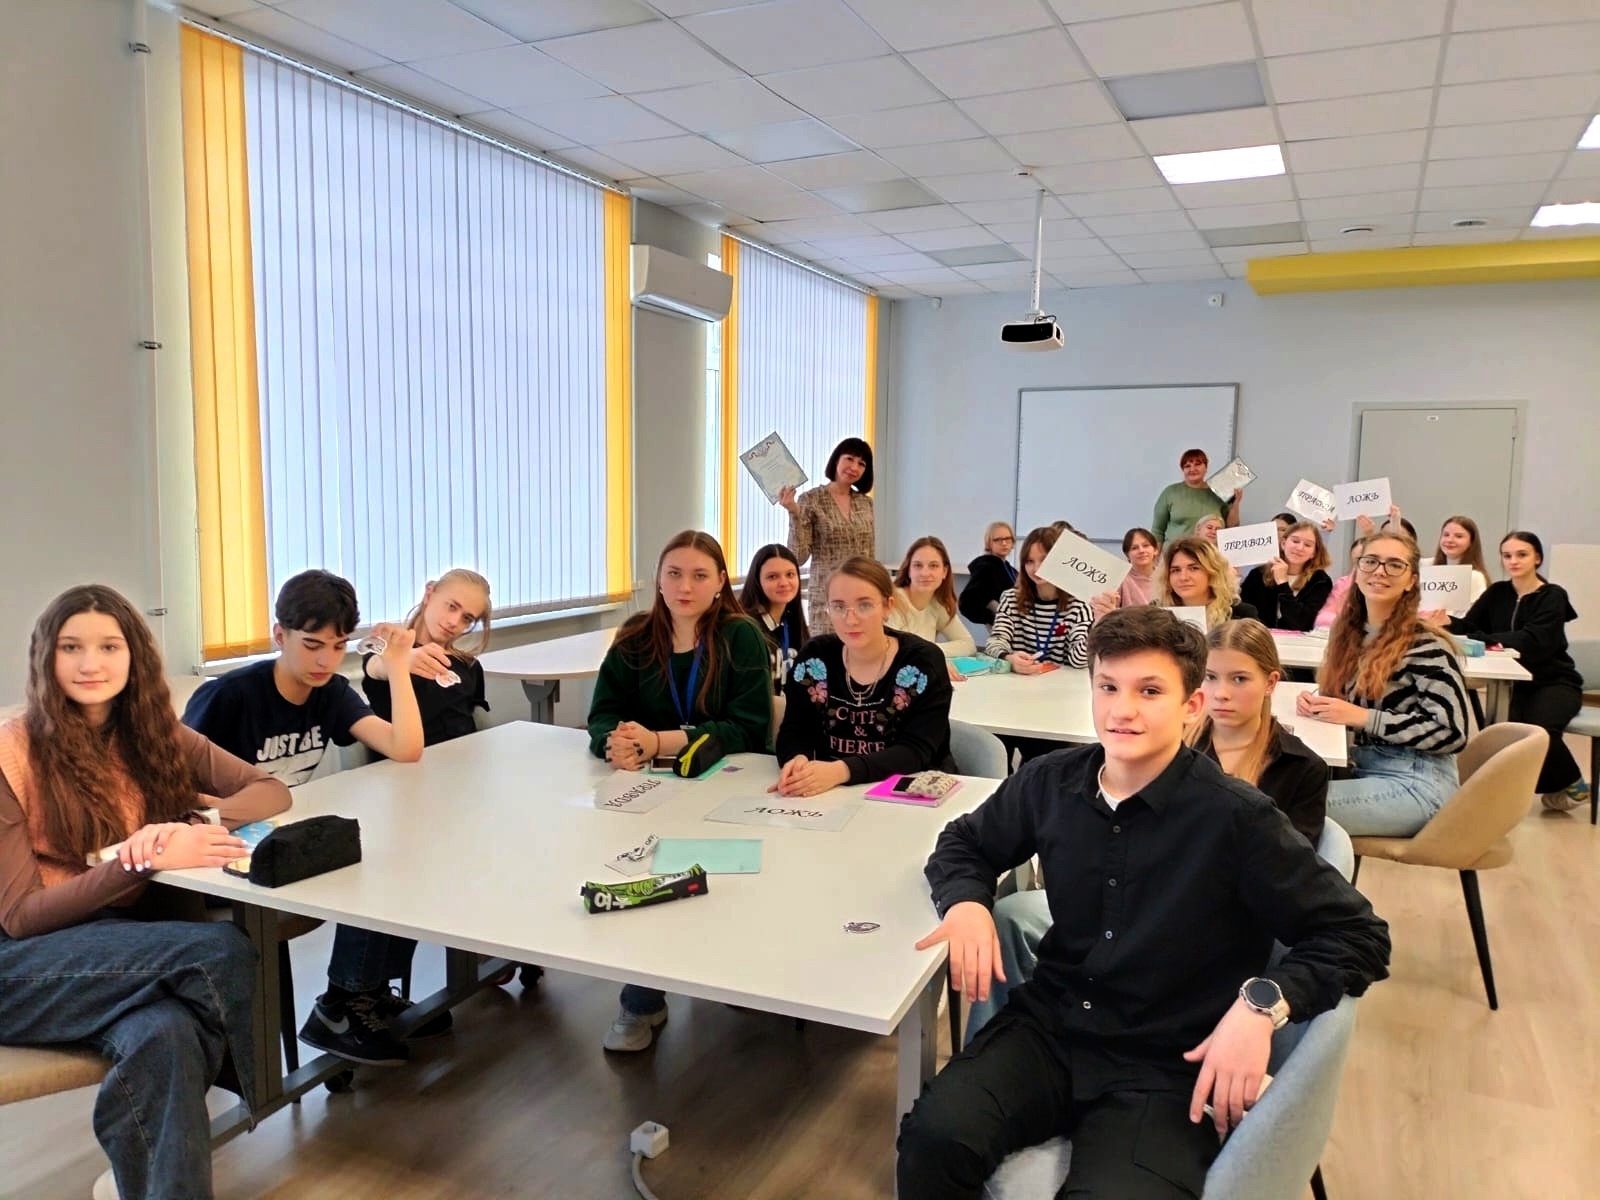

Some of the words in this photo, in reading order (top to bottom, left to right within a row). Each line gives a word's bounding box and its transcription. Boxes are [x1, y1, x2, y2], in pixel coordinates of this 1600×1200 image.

[1347, 492, 1380, 505] ЛОЖЬ
[1224, 535, 1273, 552] ПРАВДА
[1061, 556, 1108, 584] ЛОЖЬ
[854, 725, 868, 737] &
[256, 733, 300, 761] JUST
[299, 725, 324, 752] BE
[743, 807, 824, 818] ЛОЖЬ
